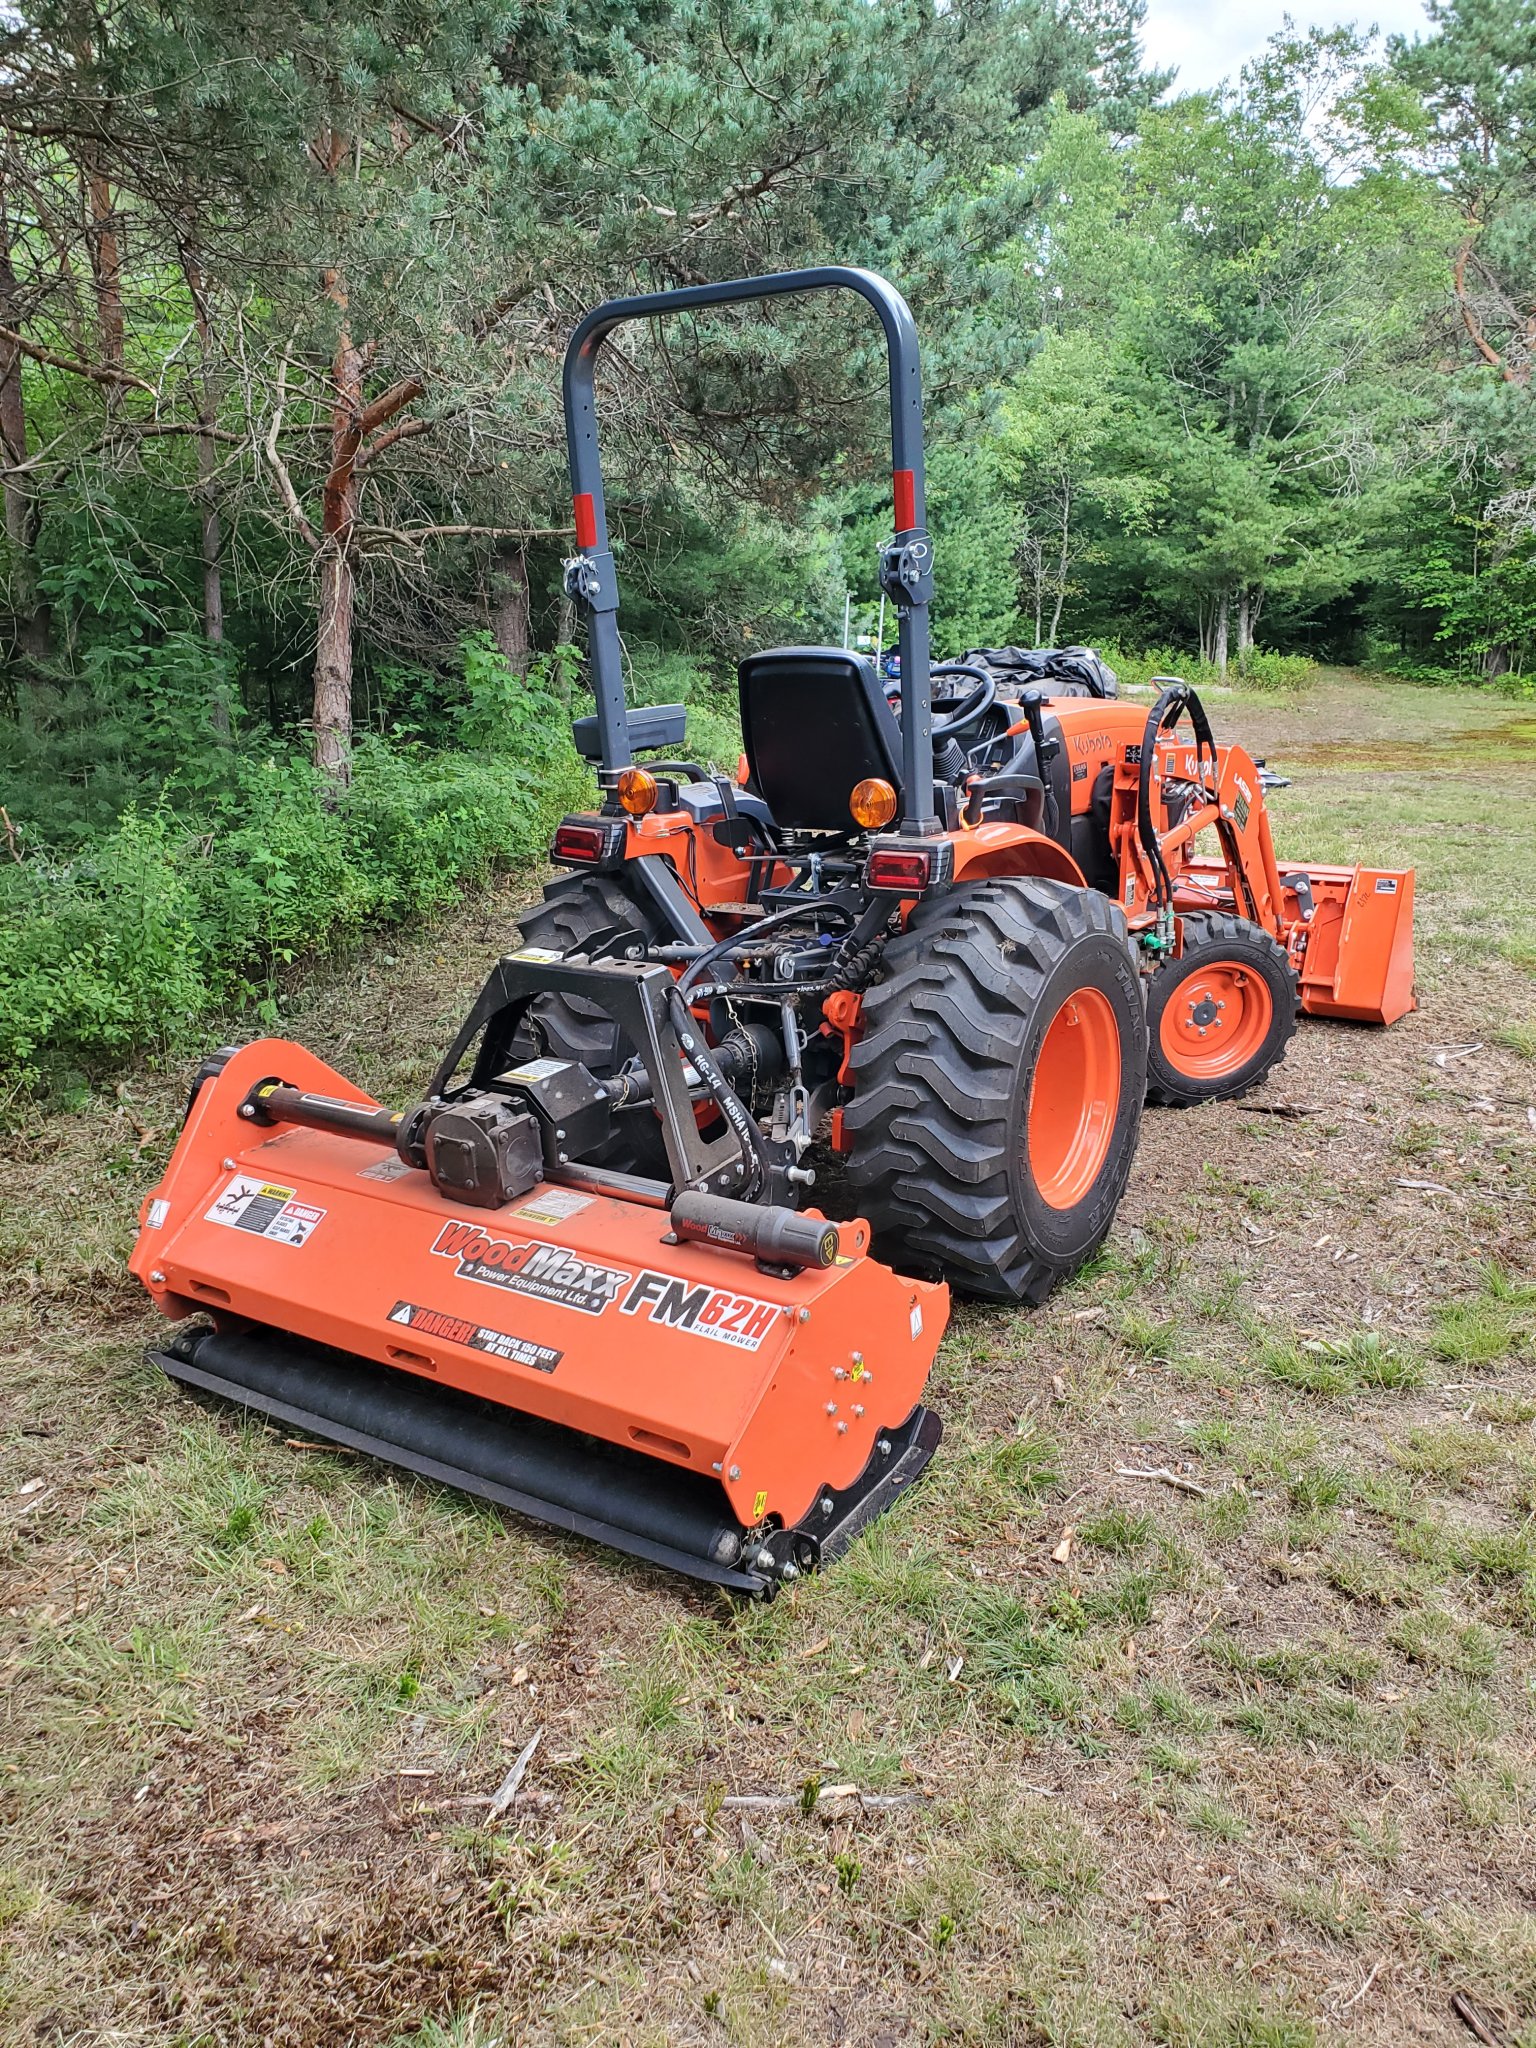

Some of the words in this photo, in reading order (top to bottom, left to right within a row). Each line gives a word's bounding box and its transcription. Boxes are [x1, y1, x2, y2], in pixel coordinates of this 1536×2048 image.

[694, 1054, 722, 1090] HG-14
[723, 1096, 746, 1132] MSHA
[433, 1222, 629, 1299] WoodMaxx
[474, 1265, 506, 1283] Power
[509, 1275, 566, 1298] Equipment
[566, 1290, 587, 1305] Ltd.
[410, 1308, 478, 1344] DANGER!
[693, 1323, 719, 1337] FLAIL
[722, 1330, 758, 1348] MOWER
[478, 1329, 499, 1341] STAY
[498, 1333, 521, 1348] BACK
[521, 1341, 537, 1354] 150
[536, 1346, 557, 1360] FEET
[485, 1342, 496, 1351] AT
[495, 1345, 511, 1357] ALL
[510, 1350, 537, 1365] TIMES
